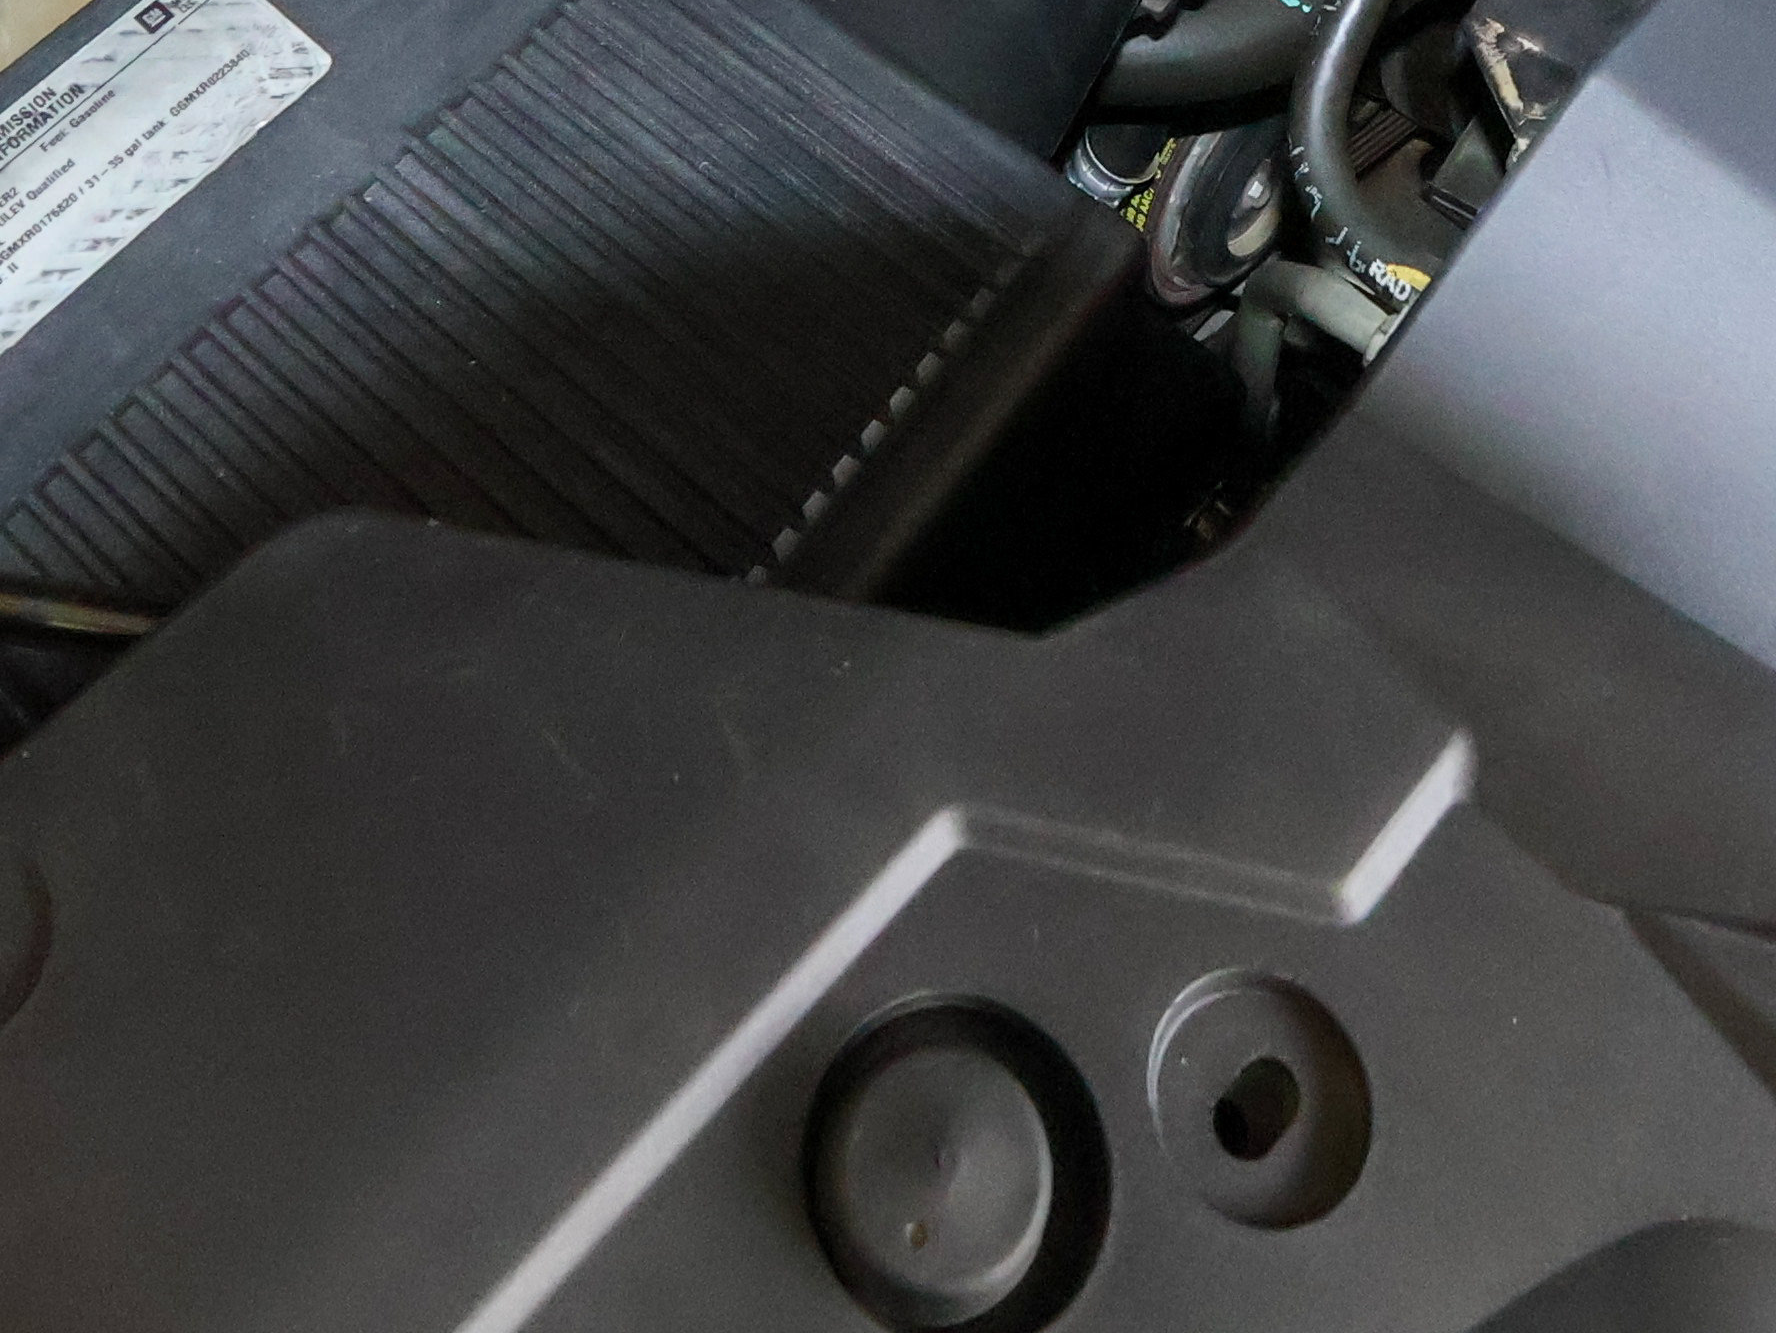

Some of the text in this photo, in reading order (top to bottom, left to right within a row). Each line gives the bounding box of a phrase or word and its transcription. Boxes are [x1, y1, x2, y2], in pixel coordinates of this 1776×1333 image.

[67, 86, 116, 130] Gasoline
[122, 137, 144, 158] gal
[24, 156, 76, 202] Qualified
[1370, 259, 1413, 302] RAD
